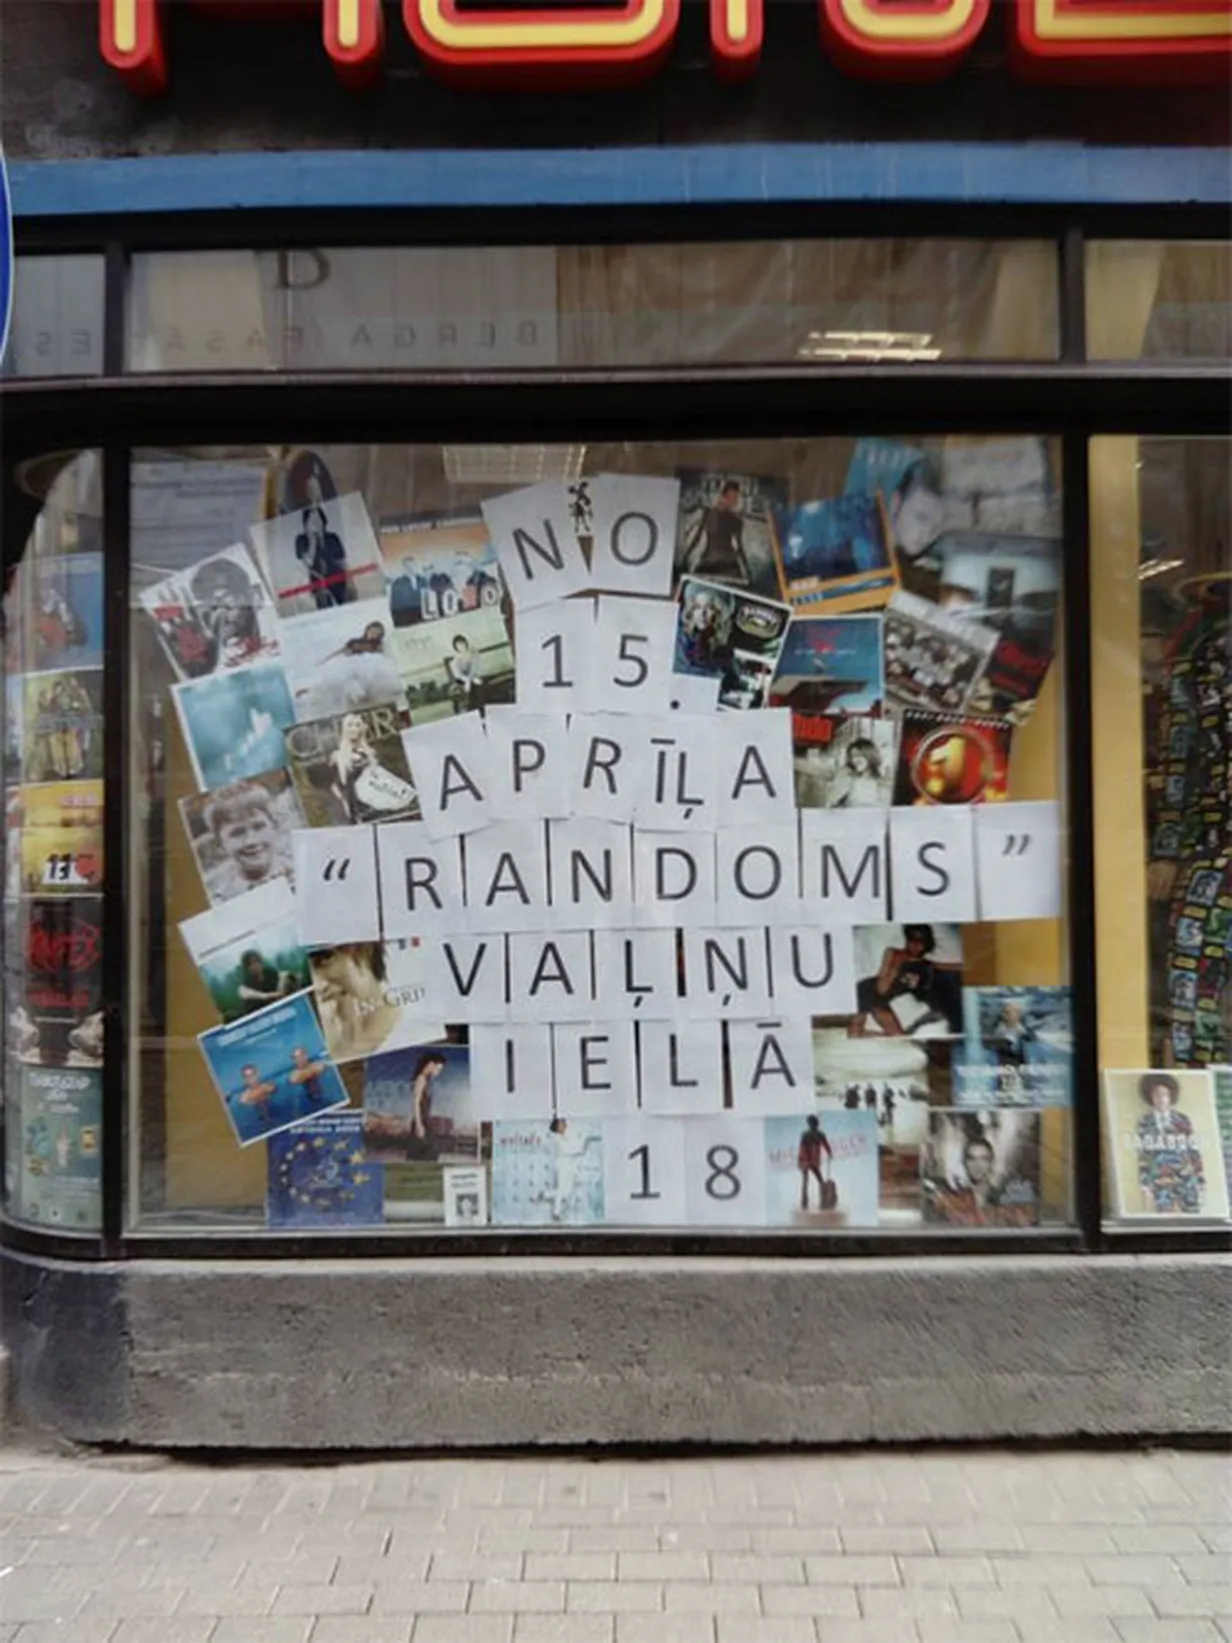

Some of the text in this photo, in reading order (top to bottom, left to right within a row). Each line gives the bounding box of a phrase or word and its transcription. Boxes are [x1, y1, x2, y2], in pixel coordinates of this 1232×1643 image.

[512, 510, 659, 580] NO
[540, 633, 681, 711] 15.
[439, 736, 777, 820] APRĪĻA
[442, 932, 834, 1008] VAĻŅU
[505, 1021, 797, 1093] IELĀ
[628, 1143, 741, 1202] 18
